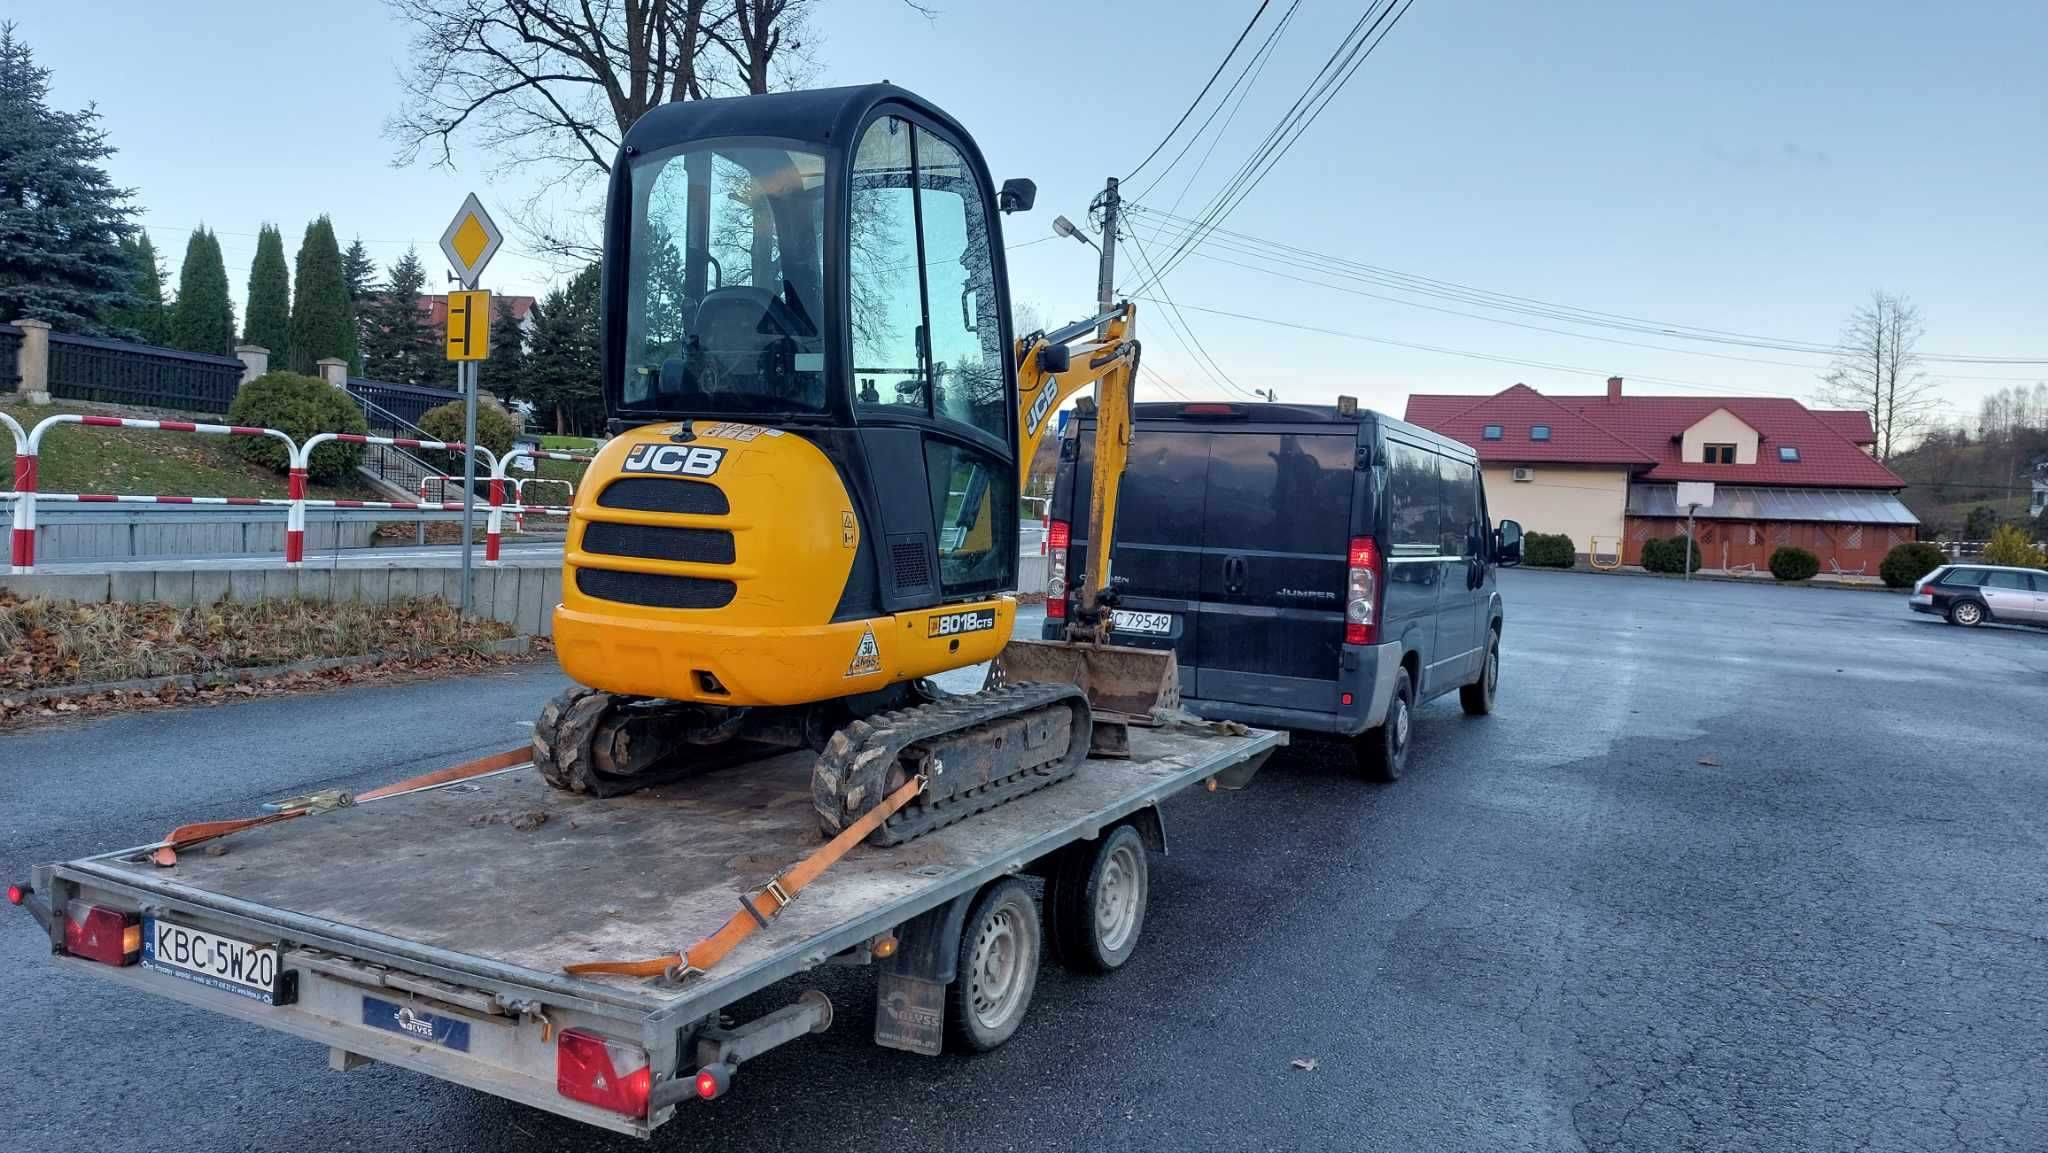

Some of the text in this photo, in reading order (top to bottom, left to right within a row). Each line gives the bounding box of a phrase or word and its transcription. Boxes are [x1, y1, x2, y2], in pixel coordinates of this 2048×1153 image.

[1028, 376, 1058, 435] JCB
[625, 445, 721, 475] JCB
[1276, 588, 1336, 599] JUMPER
[1127, 613, 1169, 629] 79549
[145, 942, 154, 953] PL
[158, 925, 207, 968] KBC
[216, 940, 273, 987] 5W20
